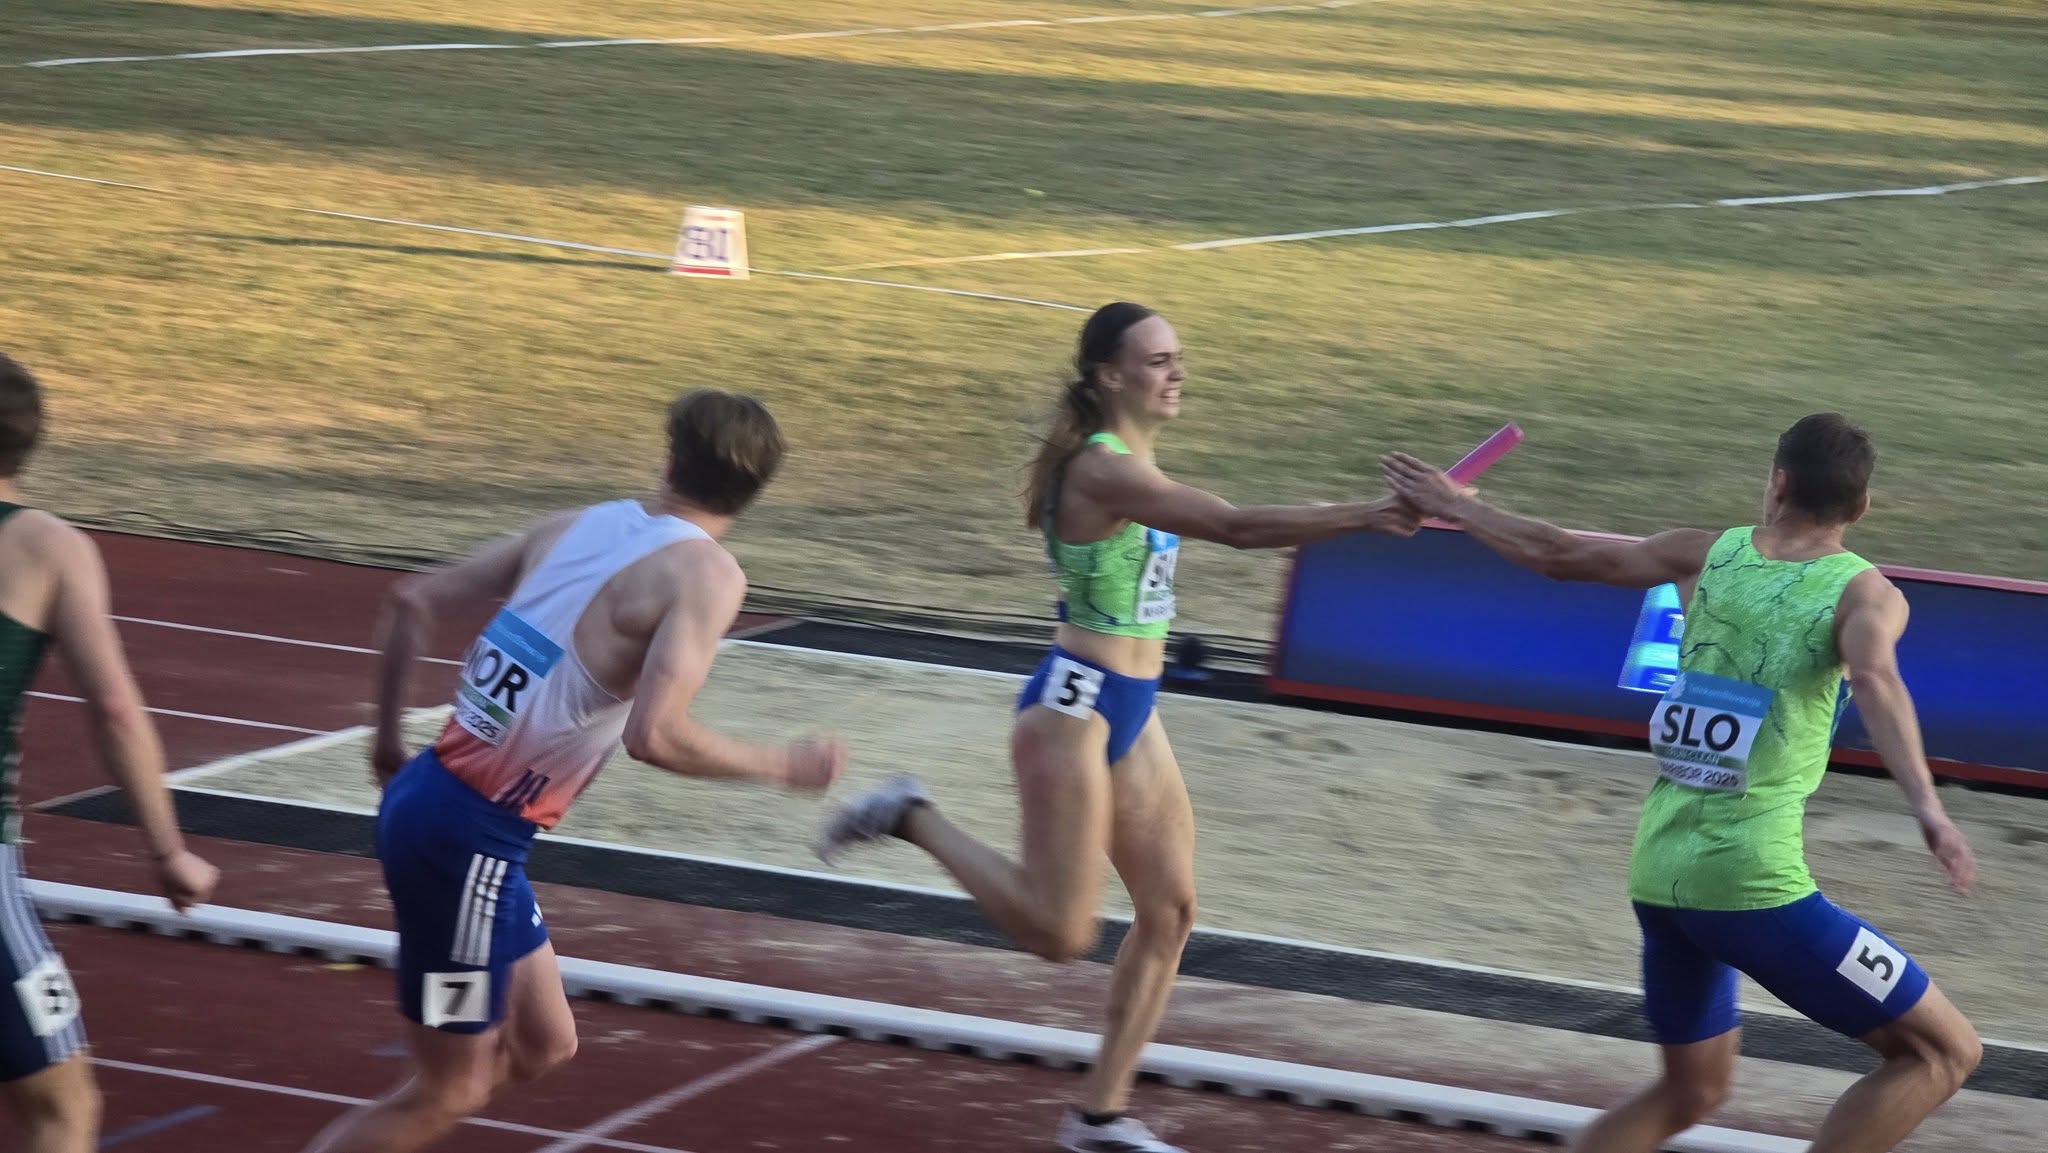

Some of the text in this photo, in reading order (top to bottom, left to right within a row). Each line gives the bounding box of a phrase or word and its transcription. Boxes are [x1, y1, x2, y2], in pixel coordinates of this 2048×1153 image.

[1056, 670, 1088, 707] 5
[1660, 704, 1740, 751] SLO
[1856, 944, 1894, 982] 5
[441, 981, 476, 1016] 7
